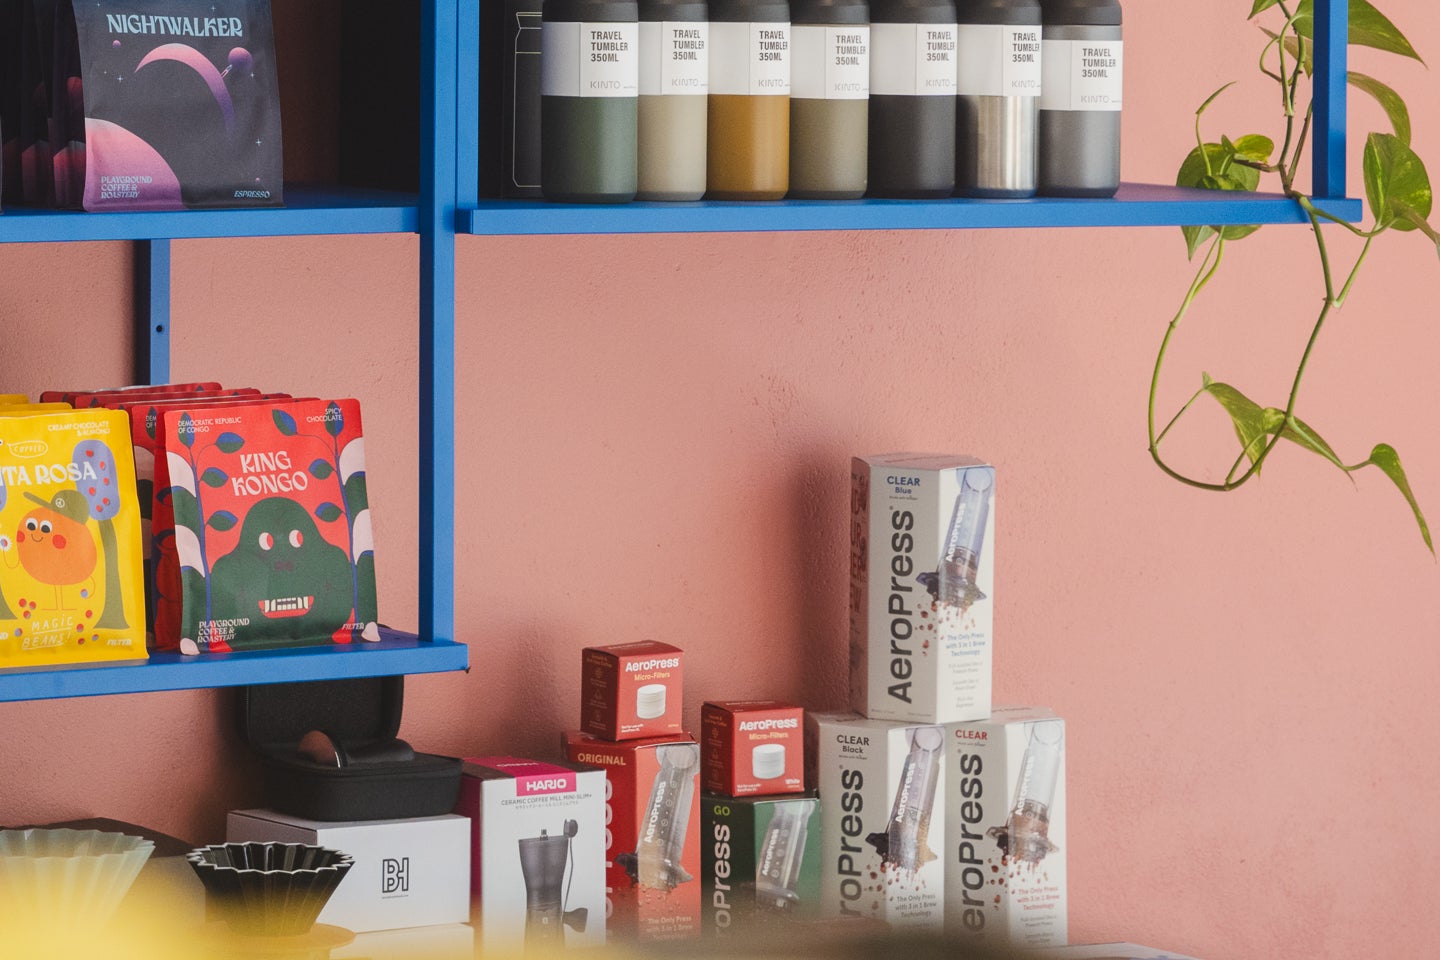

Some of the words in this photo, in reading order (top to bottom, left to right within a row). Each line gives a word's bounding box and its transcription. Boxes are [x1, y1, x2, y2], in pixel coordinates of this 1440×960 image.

[106, 14, 242, 37] NIGHTWALKER
[591, 31, 623, 40] TRAVEL
[673, 29, 700, 39] TRAVEL
[759, 31, 784, 40] TRAVEL
[927, 31, 951, 40] TRAVEL
[1013, 32, 1037, 41] TRAVEL
[836, 35, 862, 44] TRAVEL
[591, 42, 628, 51] TUMBLER
[673, 40, 704, 49] TUMBLER
[759, 41, 788, 50] TUMBLER
[927, 42, 955, 51] TUMBLER
[1013, 43, 1040, 52] TUMBLER
[836, 46, 866, 55] TUMBLER
[1082, 48, 1111, 57] TRAVEL
[590, 53, 619, 62] 350ML
[673, 51, 697, 60] 350ML
[759, 52, 782, 61] 350ML
[927, 53, 949, 61] 350ML
[1012, 54, 1034, 62] 350ML
[835, 57, 860, 65] 350ML
[1082, 58, 1116, 67] TUMBLER
[1082, 69, 1108, 78] 350ML
[590, 81, 620, 89] KINTO
[101, 176, 152, 184] PLAYGROUND
[101, 191, 140, 199] ROASTERY
[234, 190, 270, 198] ESPRESSO
[325, 408, 342, 416] SPICY
[178, 418, 213, 427] DEMOCRATIC
[215, 416, 242, 425] REPUBLIC
[307, 414, 342, 423] CHOCOLATE
[240, 451, 292, 473] KING
[34, 461, 98, 483] ROSA
[232, 471, 308, 496] KONGO
[887, 476, 920, 486] CLEAR
[888, 510, 914, 704] AeroPress
[199, 618, 249, 628] PLAYGROUND
[198, 628, 227, 636] COFFEE
[625, 658, 680, 672] AeroPress
[634, 672, 670, 681] Micro-Filters
[739, 718, 798, 732] AeroPress
[749, 732, 789, 741] Micro-Filters
[955, 729, 988, 740] CLEAR
[837, 735, 870, 746] CLEAR
[842, 745, 863, 754] Black
[578, 753, 626, 766] ORIGINAL
[527, 779, 567, 791] HARIO
[714, 806, 730, 816] GO
